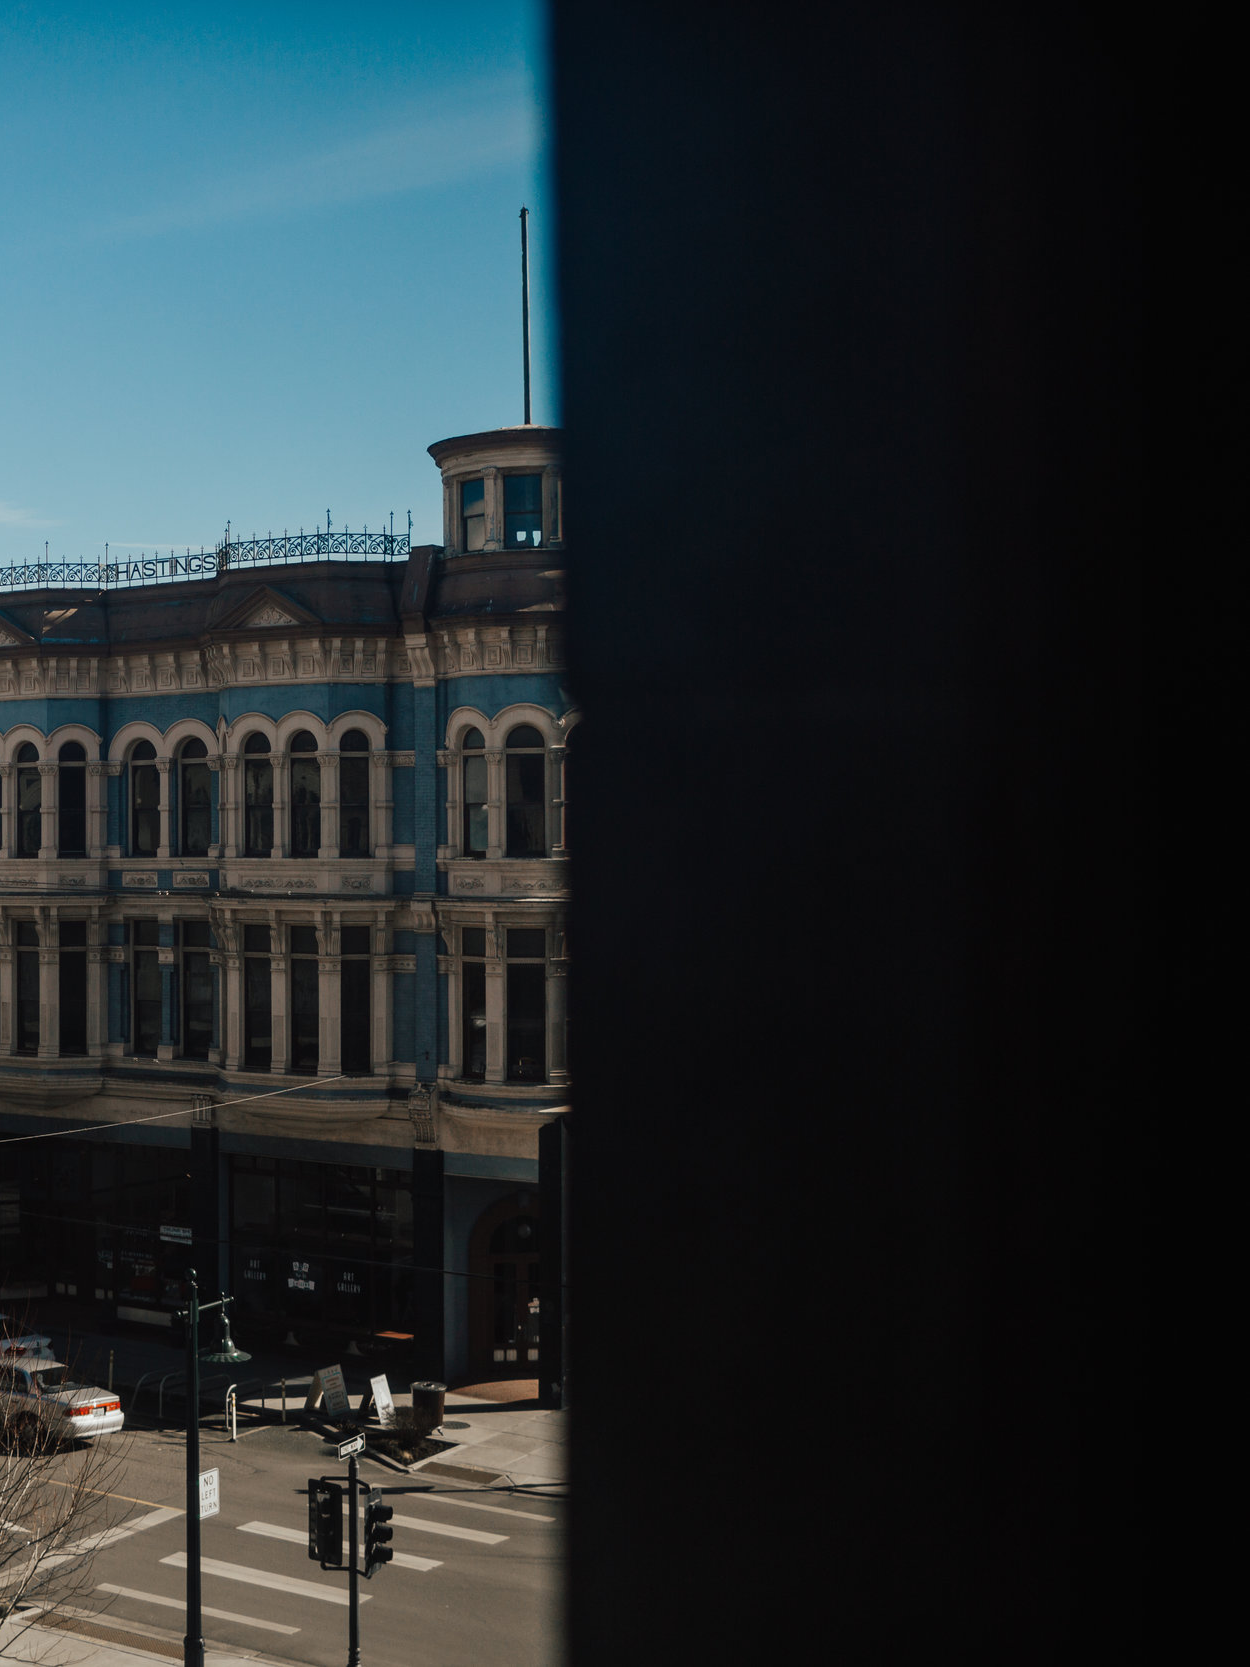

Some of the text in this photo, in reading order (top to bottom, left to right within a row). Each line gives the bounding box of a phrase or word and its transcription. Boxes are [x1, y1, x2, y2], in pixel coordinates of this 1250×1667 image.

[116, 555, 217, 581] HASTINGS
[203, 1474, 214, 1487] NO
[201, 1488, 216, 1501] LEFT
[200, 1501, 218, 1513] TURN
